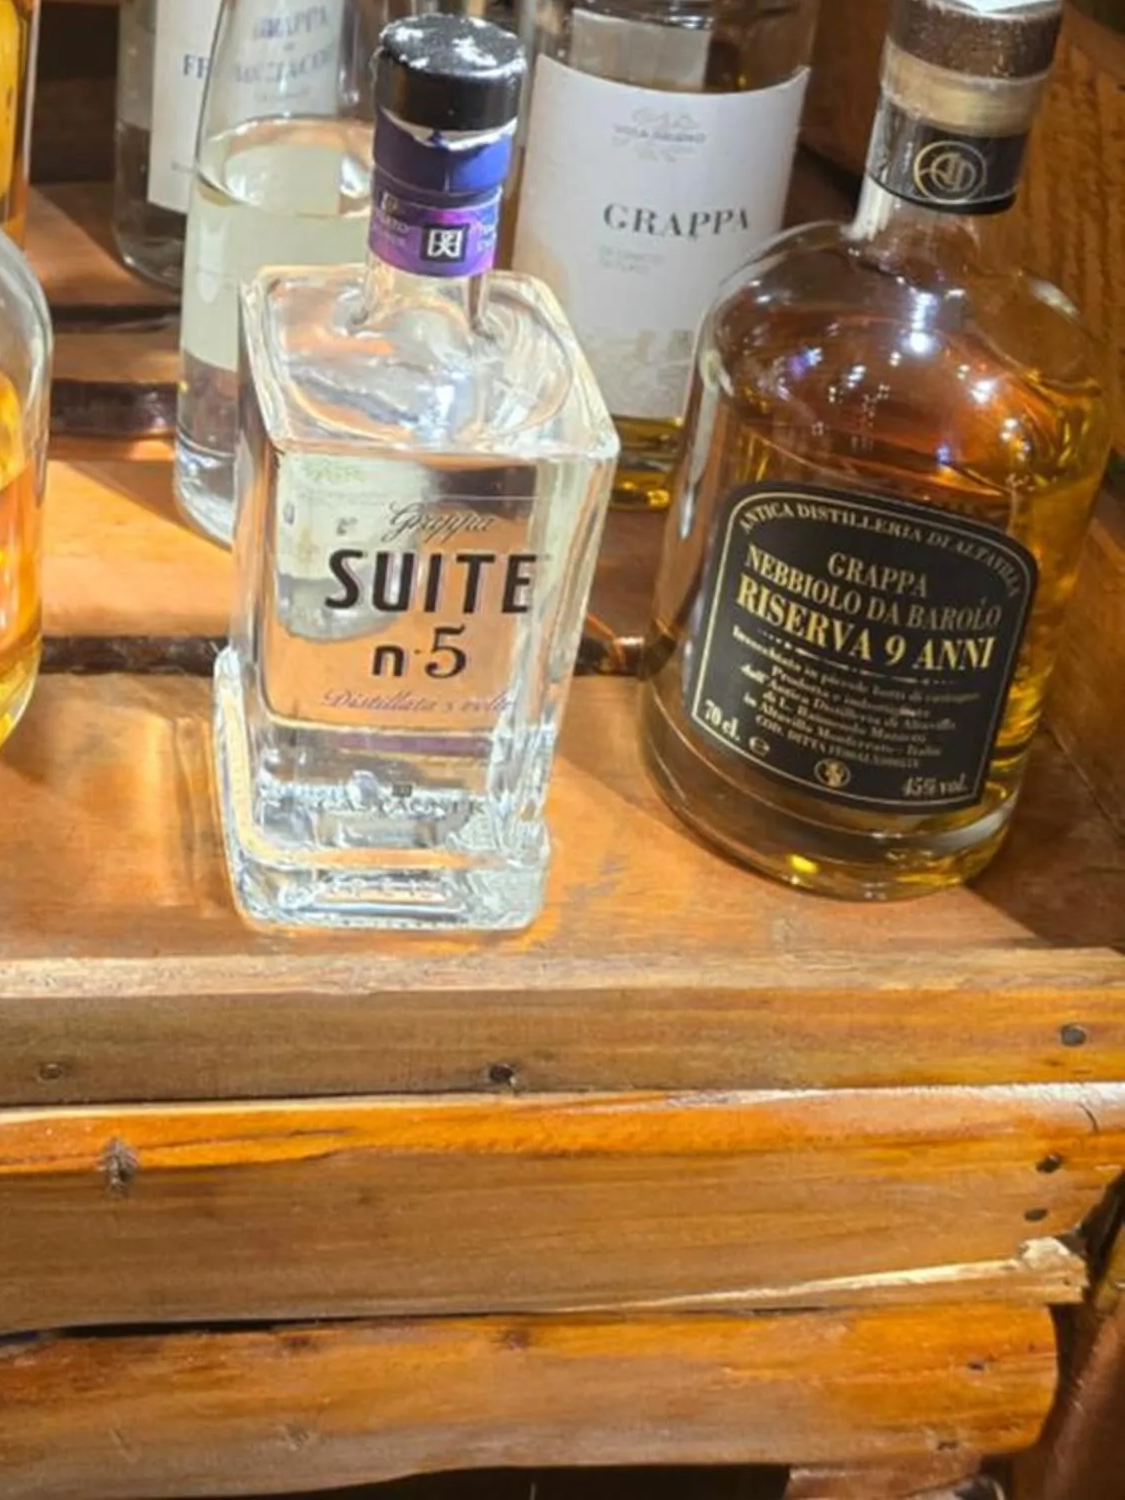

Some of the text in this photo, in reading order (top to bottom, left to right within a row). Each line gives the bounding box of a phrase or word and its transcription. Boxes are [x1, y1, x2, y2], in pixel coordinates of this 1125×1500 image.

[603, 203, 751, 238] GRAPPA
[325, 548, 539, 614] SUITE
[738, 501, 1022, 599] ANTICA DISTILLERIA DI ALTAVILLA
[743, 543, 863, 617] NEBBIOLO
[865, 596, 902, 628] DA
[827, 551, 928, 598] GRAPPA
[735, 572, 998, 672] RISERVA 9 ANNI
